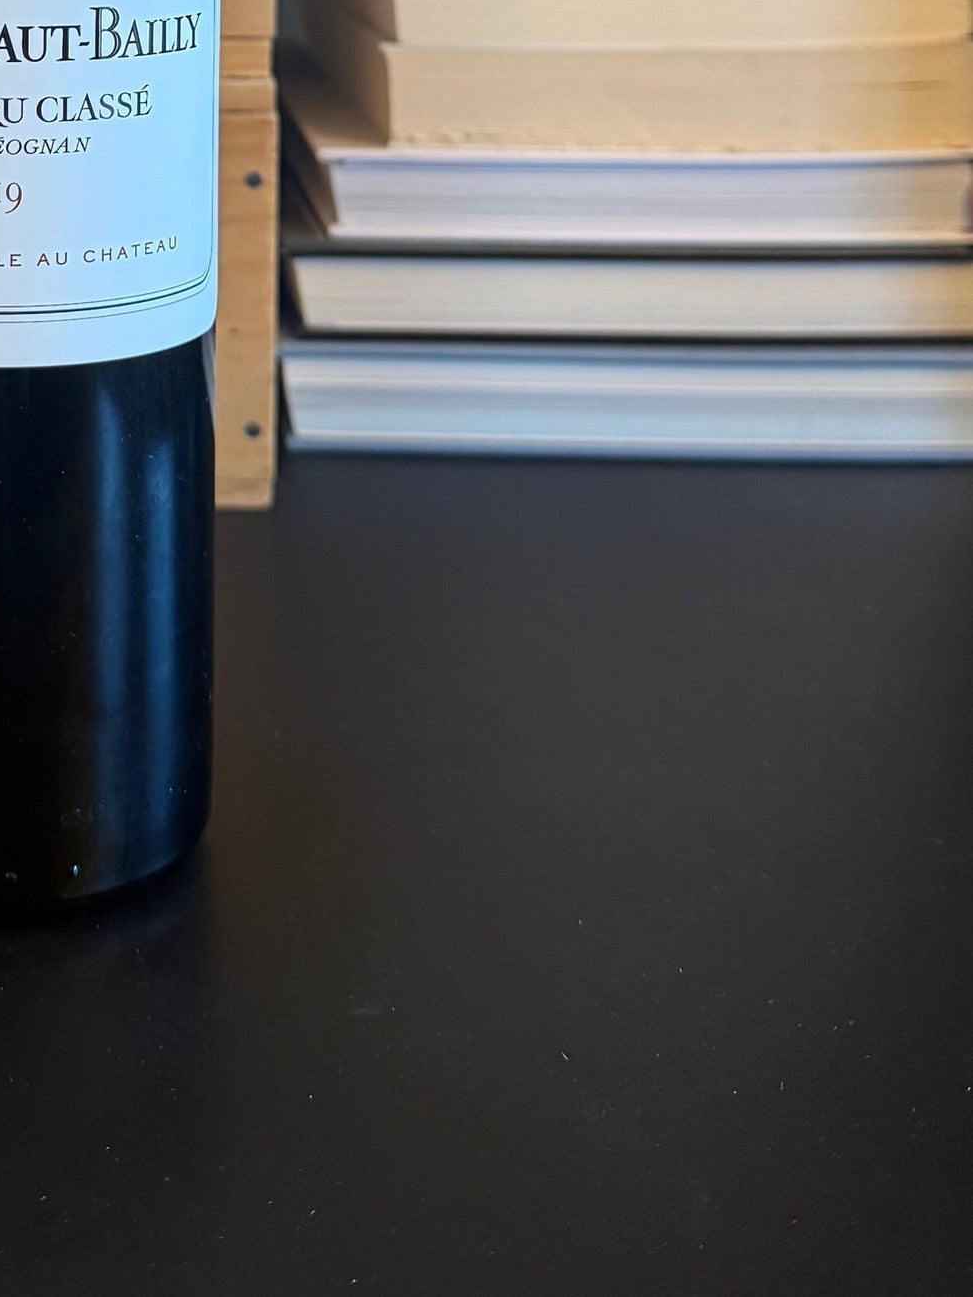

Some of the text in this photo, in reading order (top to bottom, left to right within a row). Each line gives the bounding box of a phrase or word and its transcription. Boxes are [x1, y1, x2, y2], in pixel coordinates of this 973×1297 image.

[35, 83, 153, 123] CLASSÉ
[36, 251, 68, 267] AU
[82, 235, 177, 264] CHATEAU
